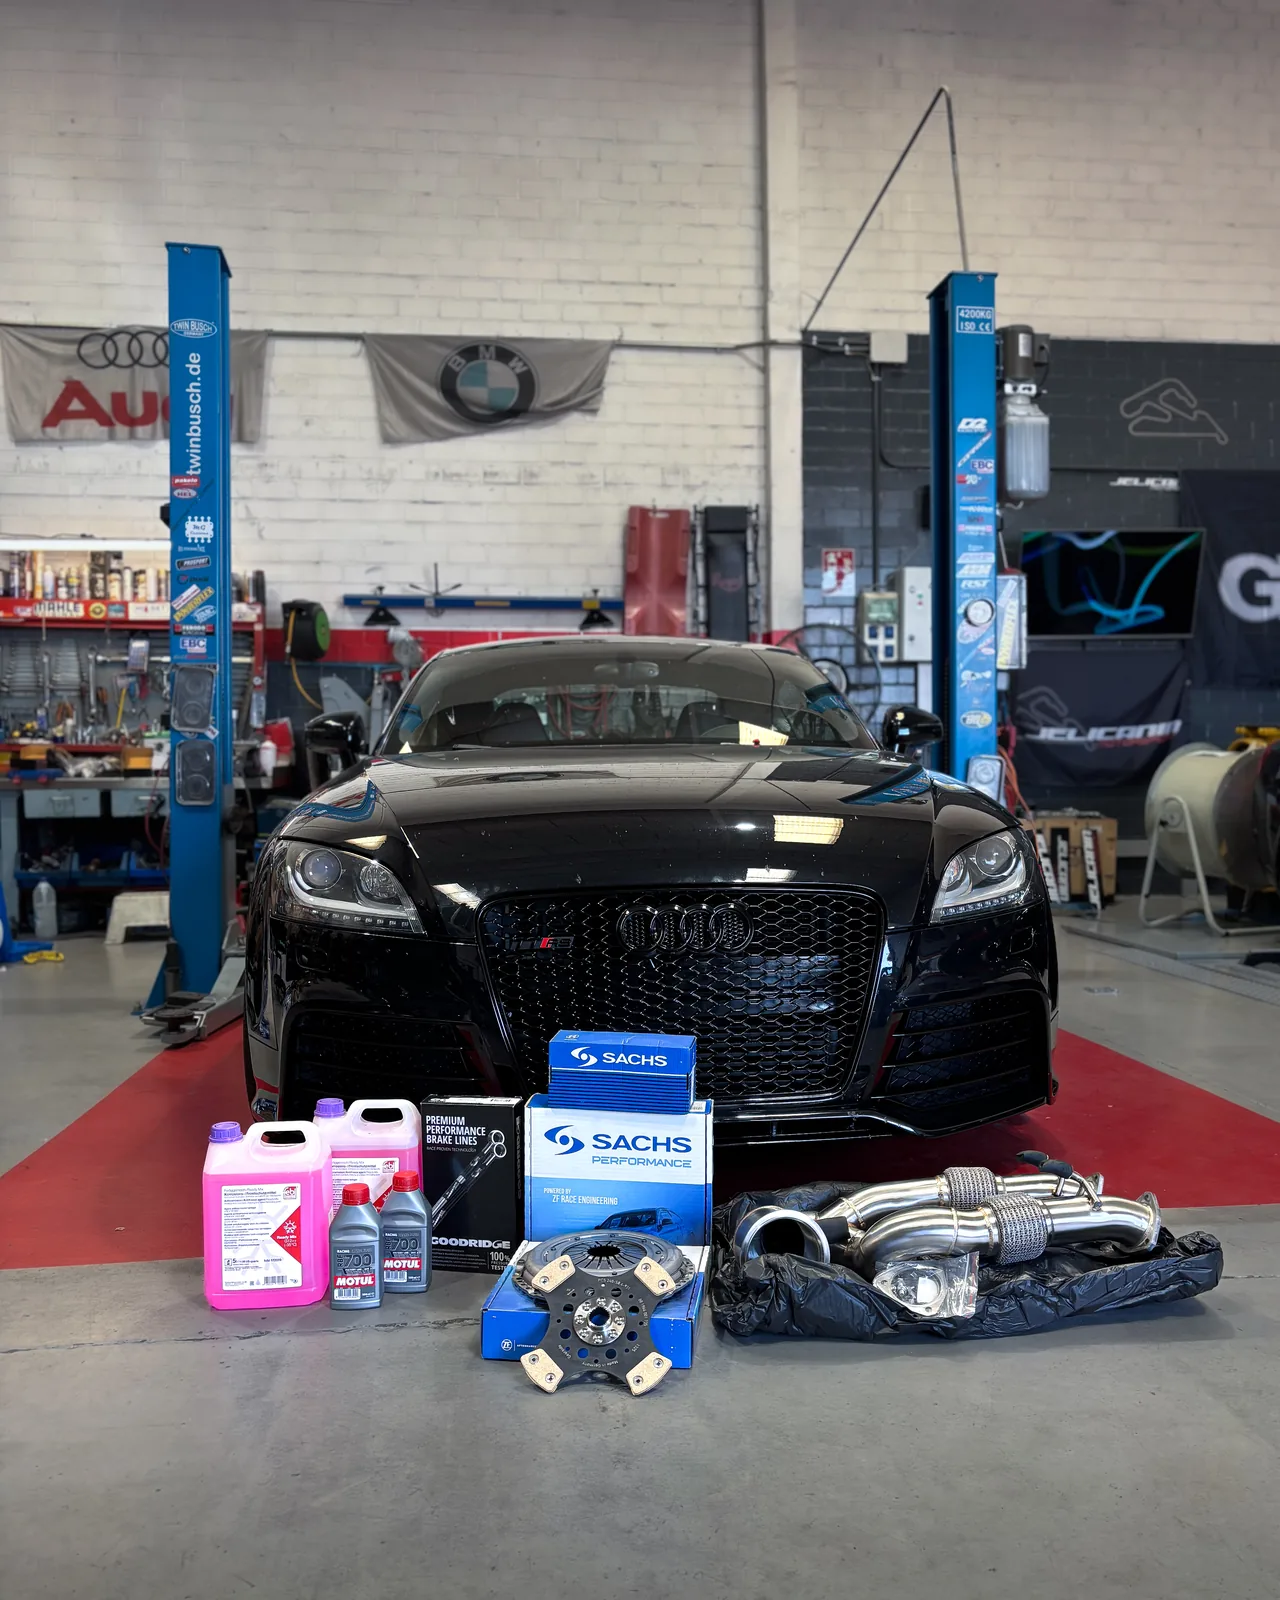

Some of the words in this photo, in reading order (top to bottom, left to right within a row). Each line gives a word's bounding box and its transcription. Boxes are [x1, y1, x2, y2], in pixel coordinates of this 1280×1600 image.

[959, 309, 992, 319] 4200KG
[174, 320, 190, 330] TWIN
[191, 320, 213, 332] BUSCH
[960, 321, 976, 331] ISO
[448, 345, 529, 375] BMW
[185, 352, 202, 476] twinbusch.de
[971, 460, 993, 469] EBC
[1218, 552, 1280, 624] G
[37, 602, 81, 613] MAHLE
[181, 638, 206, 648] EBC
[602, 1052, 668, 1067] SACHS
[426, 1115, 466, 1126] PREMIUM
[426, 1125, 486, 1136] PERFORMANCE
[426, 1135, 453, 1145] BRAKE
[455, 1135, 478, 1146] LINES
[592, 1133, 693, 1153] SACHS
[592, 1155, 692, 1168] PERFORMANCE
[543, 1187, 565, 1195] POWERED
[552, 1194, 560, 1202] ZF
[560, 1195, 577, 1204] RACE
[578, 1195, 619, 1206] ENGINEERING
[391, 1238, 420, 1251] 700
[432, 1237, 511, 1249] GOODRIDGE
[343, 1254, 373, 1268] 700
[384, 1260, 420, 1269] MOTUL
[336, 1275, 374, 1286] MOTUL
